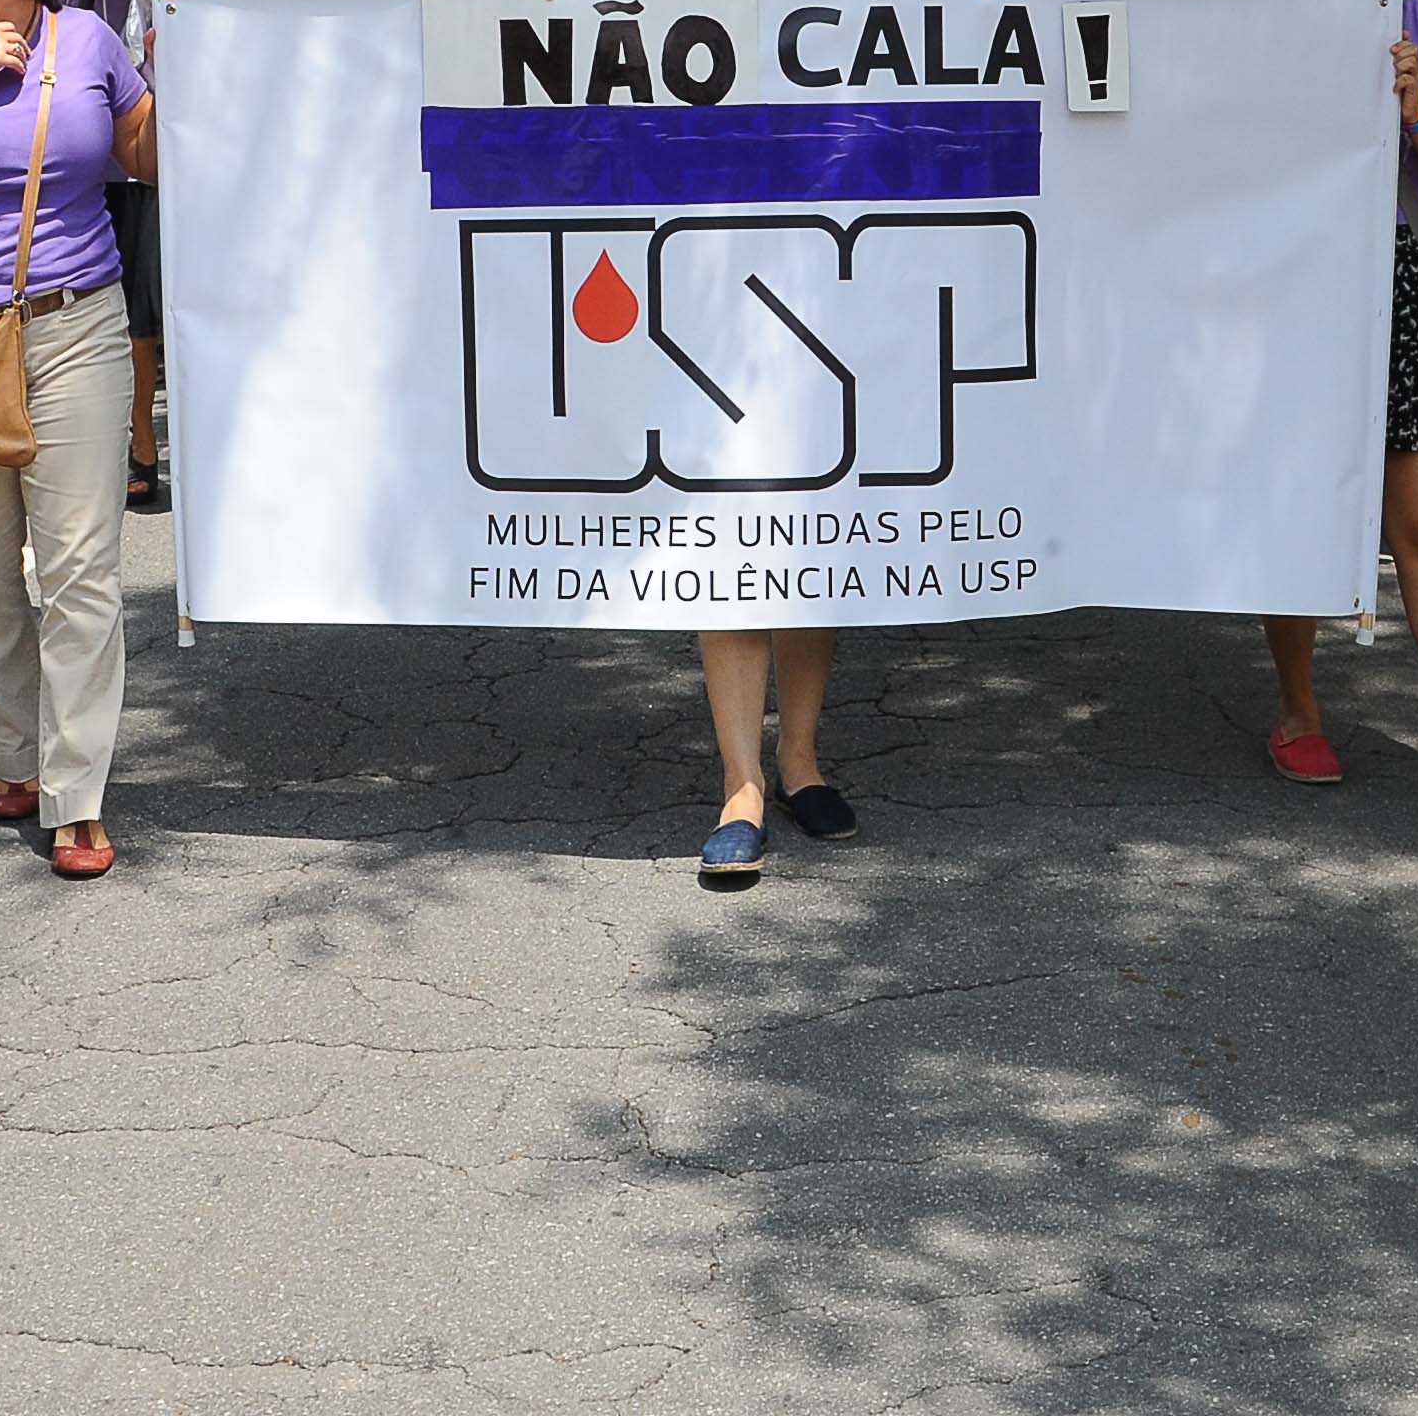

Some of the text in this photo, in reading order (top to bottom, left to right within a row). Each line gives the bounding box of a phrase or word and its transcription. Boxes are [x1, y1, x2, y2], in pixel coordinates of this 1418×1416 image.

[499, 0, 1111, 107] NÃO CALA !
[459, 211, 1037, 493] USP
[487, 506, 1022, 548] MULHERES UNIDAS PELO
[470, 558, 1037, 602] FIM DA VIOLÊNCIA NA USP
